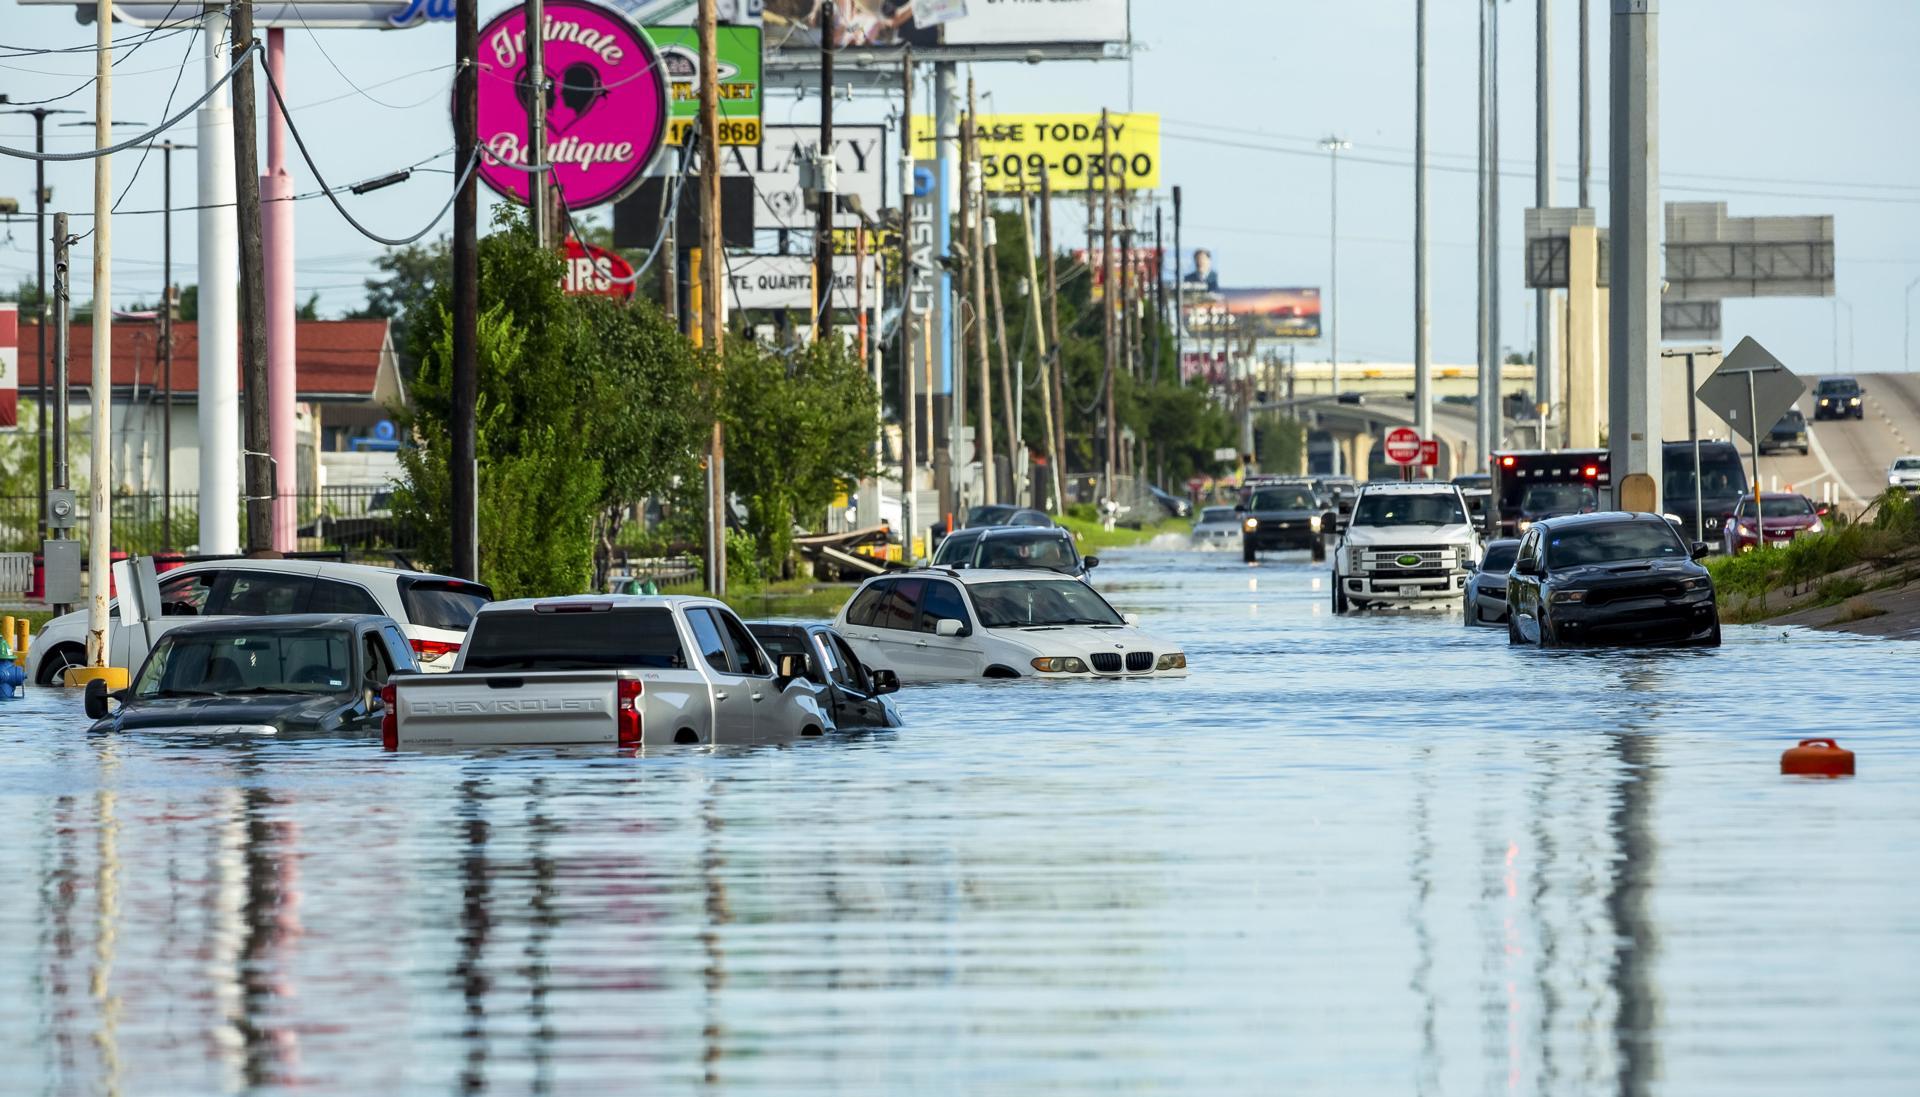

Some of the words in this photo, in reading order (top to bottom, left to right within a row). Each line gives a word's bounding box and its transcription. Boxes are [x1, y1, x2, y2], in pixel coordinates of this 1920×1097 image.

[491, 15, 623, 68] Inimate
[672, 82, 756, 100] PLNET
[1034, 123, 1125, 142] TODAY
[910, 202, 935, 316] CHASE
[410, 698, 603, 715] CHEVROLET
